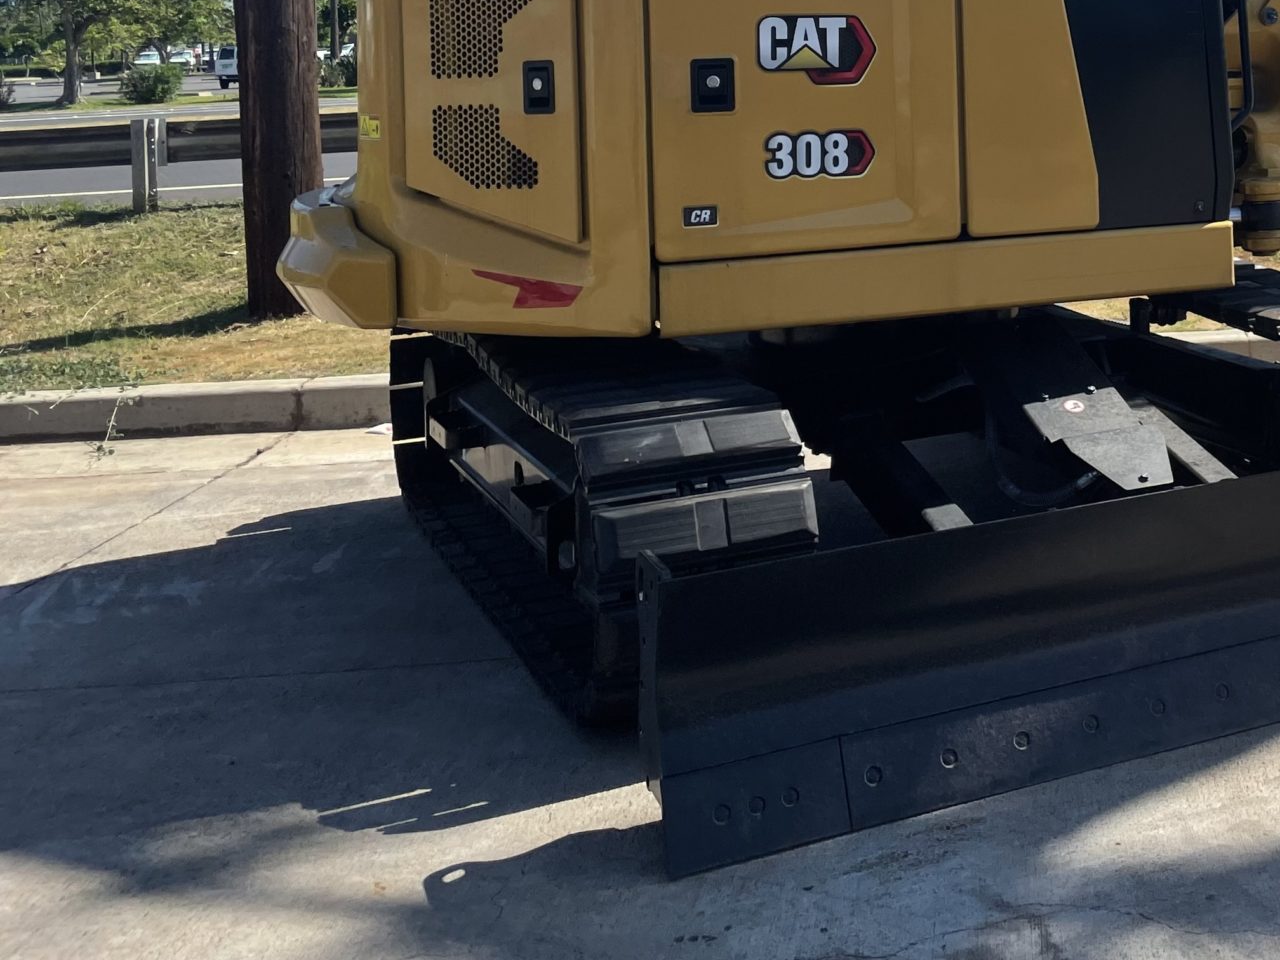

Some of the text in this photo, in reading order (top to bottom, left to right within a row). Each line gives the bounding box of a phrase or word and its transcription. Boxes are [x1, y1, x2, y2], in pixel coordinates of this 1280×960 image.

[759, 17, 847, 70] CAT
[767, 133, 849, 177] 308
[690, 209, 711, 223] CR
